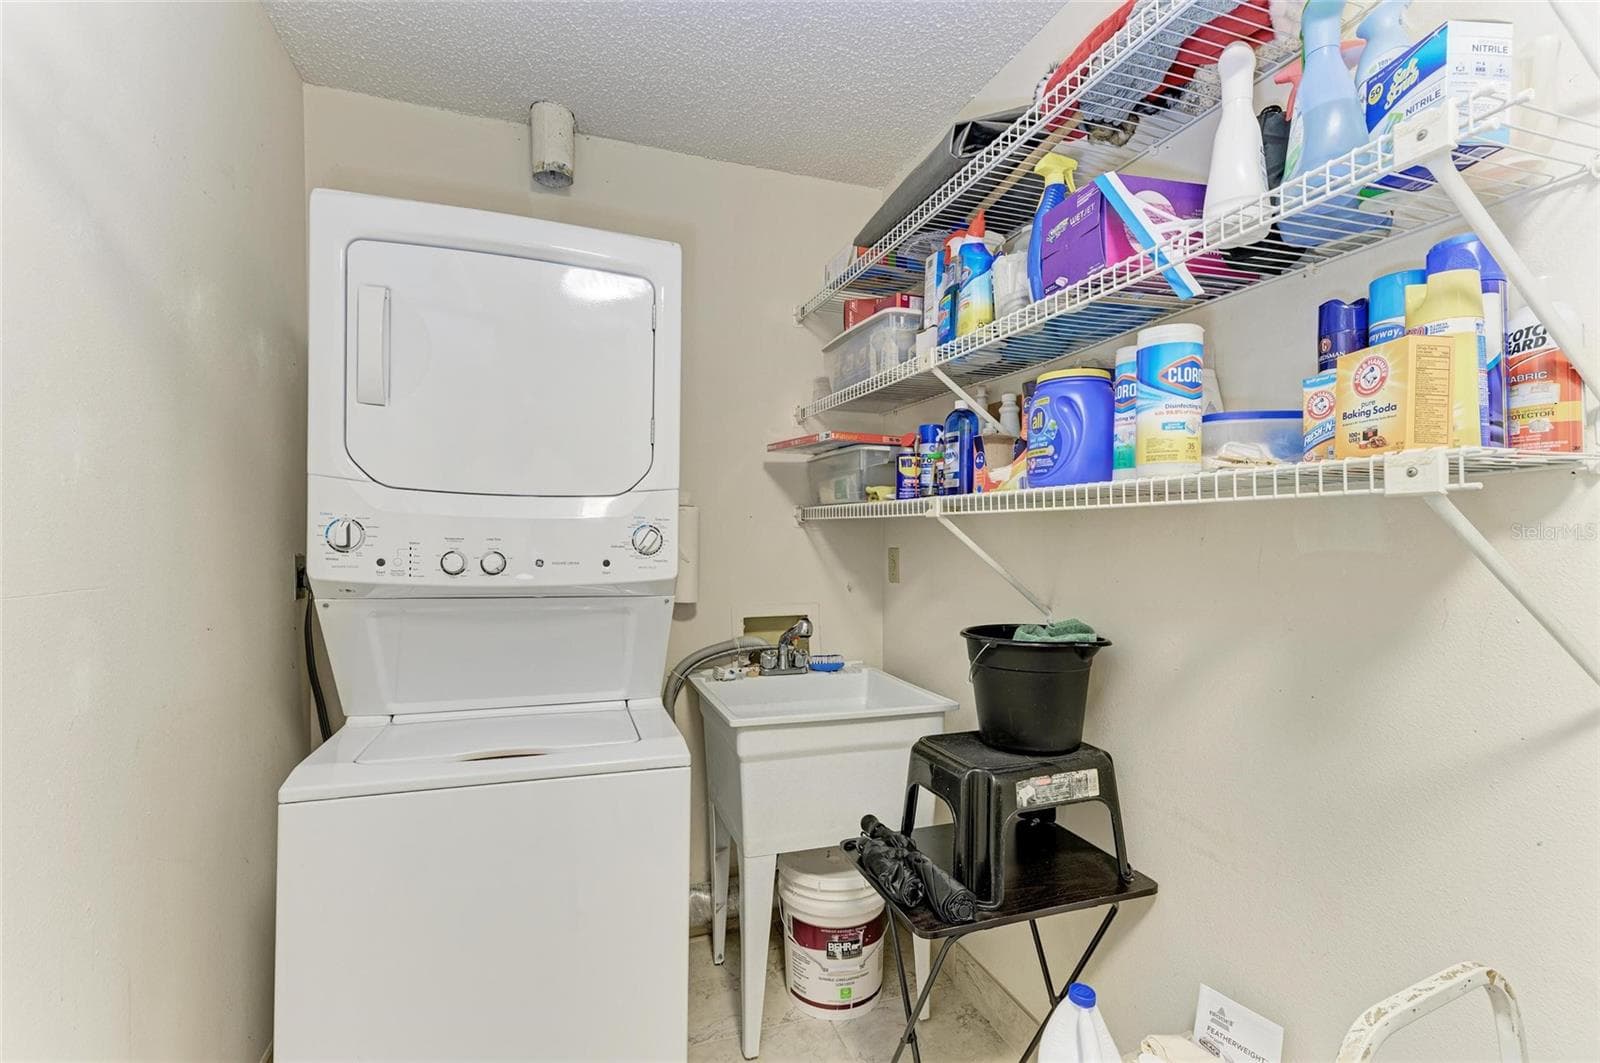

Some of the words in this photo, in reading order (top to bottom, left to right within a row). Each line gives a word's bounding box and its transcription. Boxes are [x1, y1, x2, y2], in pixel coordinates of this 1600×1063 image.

[1472, 44, 1509, 54] NITRILE
[1370, 86, 1381, 99] 50
[1405, 89, 1441, 117] NITRILE
[1032, 411, 1043, 430] all
[1342, 408, 1371, 421] Baking
[1372, 403, 1397, 415] Soda
[828, 942, 852, 953] BEHR
[1206, 1025, 1266, 1063] FEATHERWEIGHT
